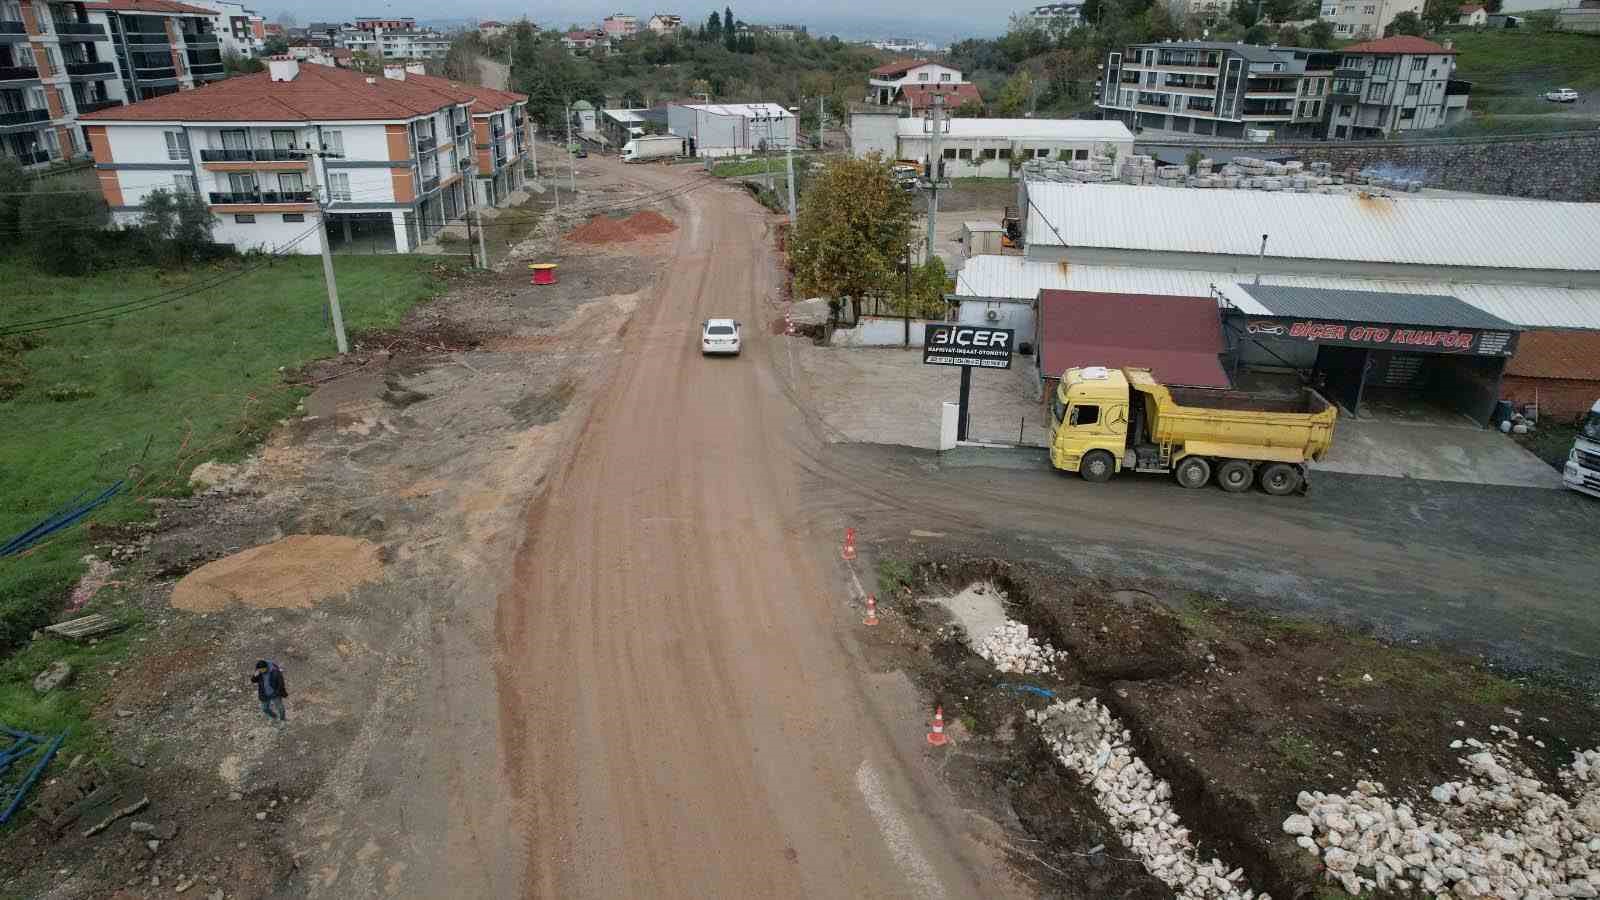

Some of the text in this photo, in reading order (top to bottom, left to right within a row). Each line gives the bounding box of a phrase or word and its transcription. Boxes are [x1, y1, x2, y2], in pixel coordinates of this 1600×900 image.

[932, 326, 1009, 347] BİÇER
[1289, 320, 1346, 341] BİÇER
[1349, 326, 1390, 342] OTO
[1391, 329, 1473, 349] KUAFÖR
